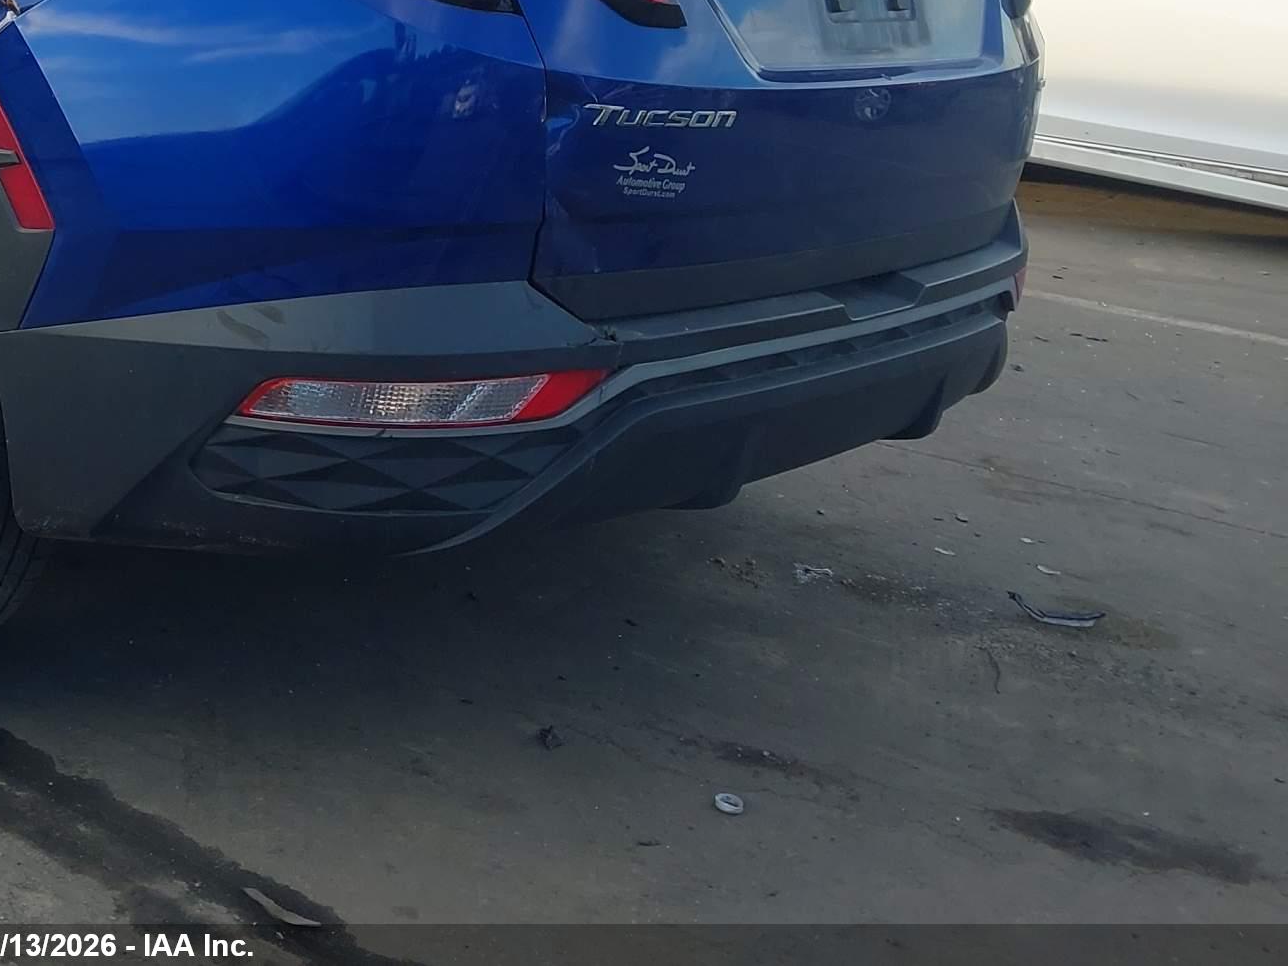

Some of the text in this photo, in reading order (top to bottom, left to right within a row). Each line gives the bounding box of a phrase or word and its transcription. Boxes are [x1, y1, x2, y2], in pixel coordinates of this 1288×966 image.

[613, 145, 659, 175] Sport
[616, 175, 686, 193] Automotive Group
